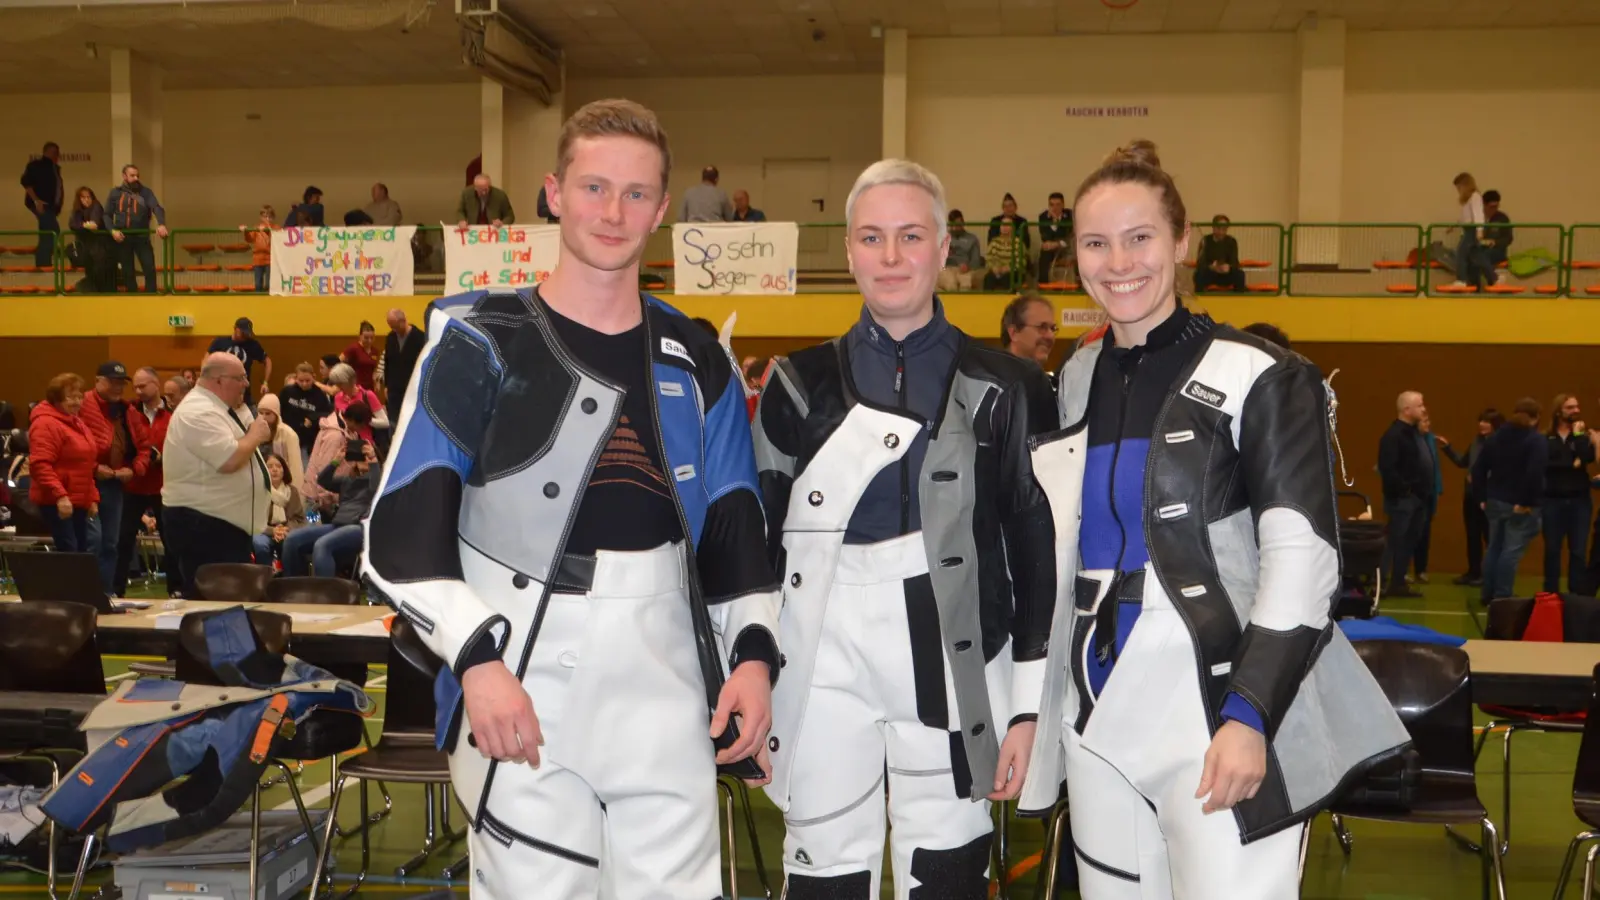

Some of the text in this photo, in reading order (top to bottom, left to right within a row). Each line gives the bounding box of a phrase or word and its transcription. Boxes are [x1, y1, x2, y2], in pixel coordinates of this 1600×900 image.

[284, 226, 314, 247] Die
[683, 228, 774, 265] So sehn
[304, 249, 383, 275] grüßt ihre
[503, 247, 532, 263] und
[281, 273, 392, 296] HESSELBERGER
[458, 270, 490, 291] Gut
[761, 268, 795, 291] aus!
[1063, 311, 1103, 325] RAUCHE
[665, 341, 688, 355] Sau
[1191, 384, 1221, 404] Sauer
